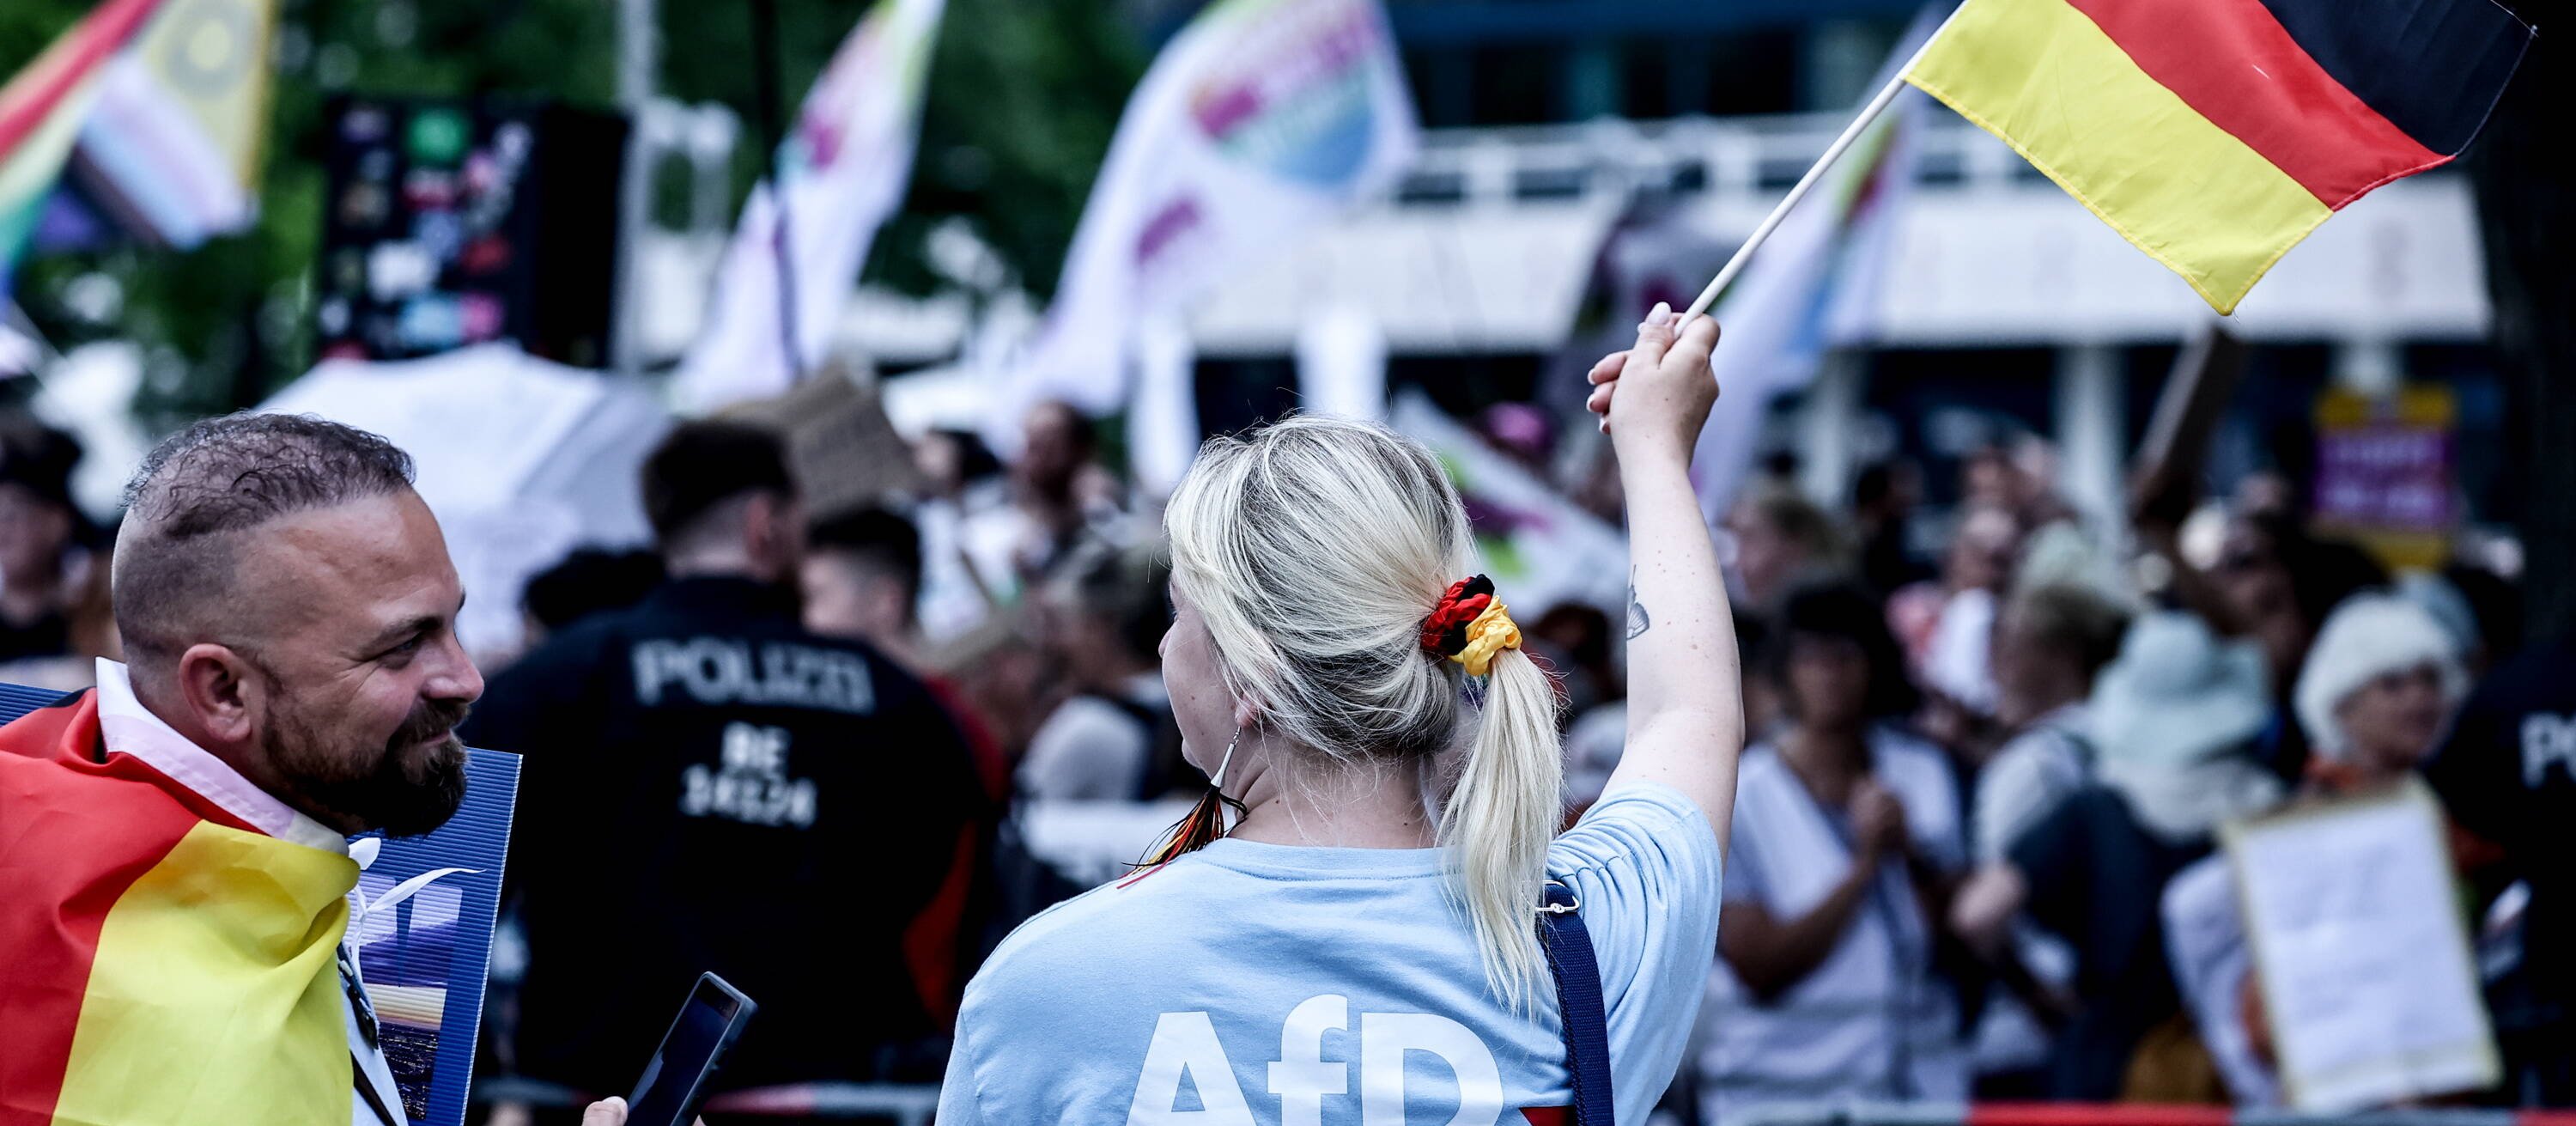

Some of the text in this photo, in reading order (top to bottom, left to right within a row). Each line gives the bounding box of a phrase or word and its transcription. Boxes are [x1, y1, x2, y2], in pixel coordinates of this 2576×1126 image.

[632, 639, 874, 713] POLIZEI
[720, 721, 790, 773] BE
[1126, 994, 1504, 1126] AfD
